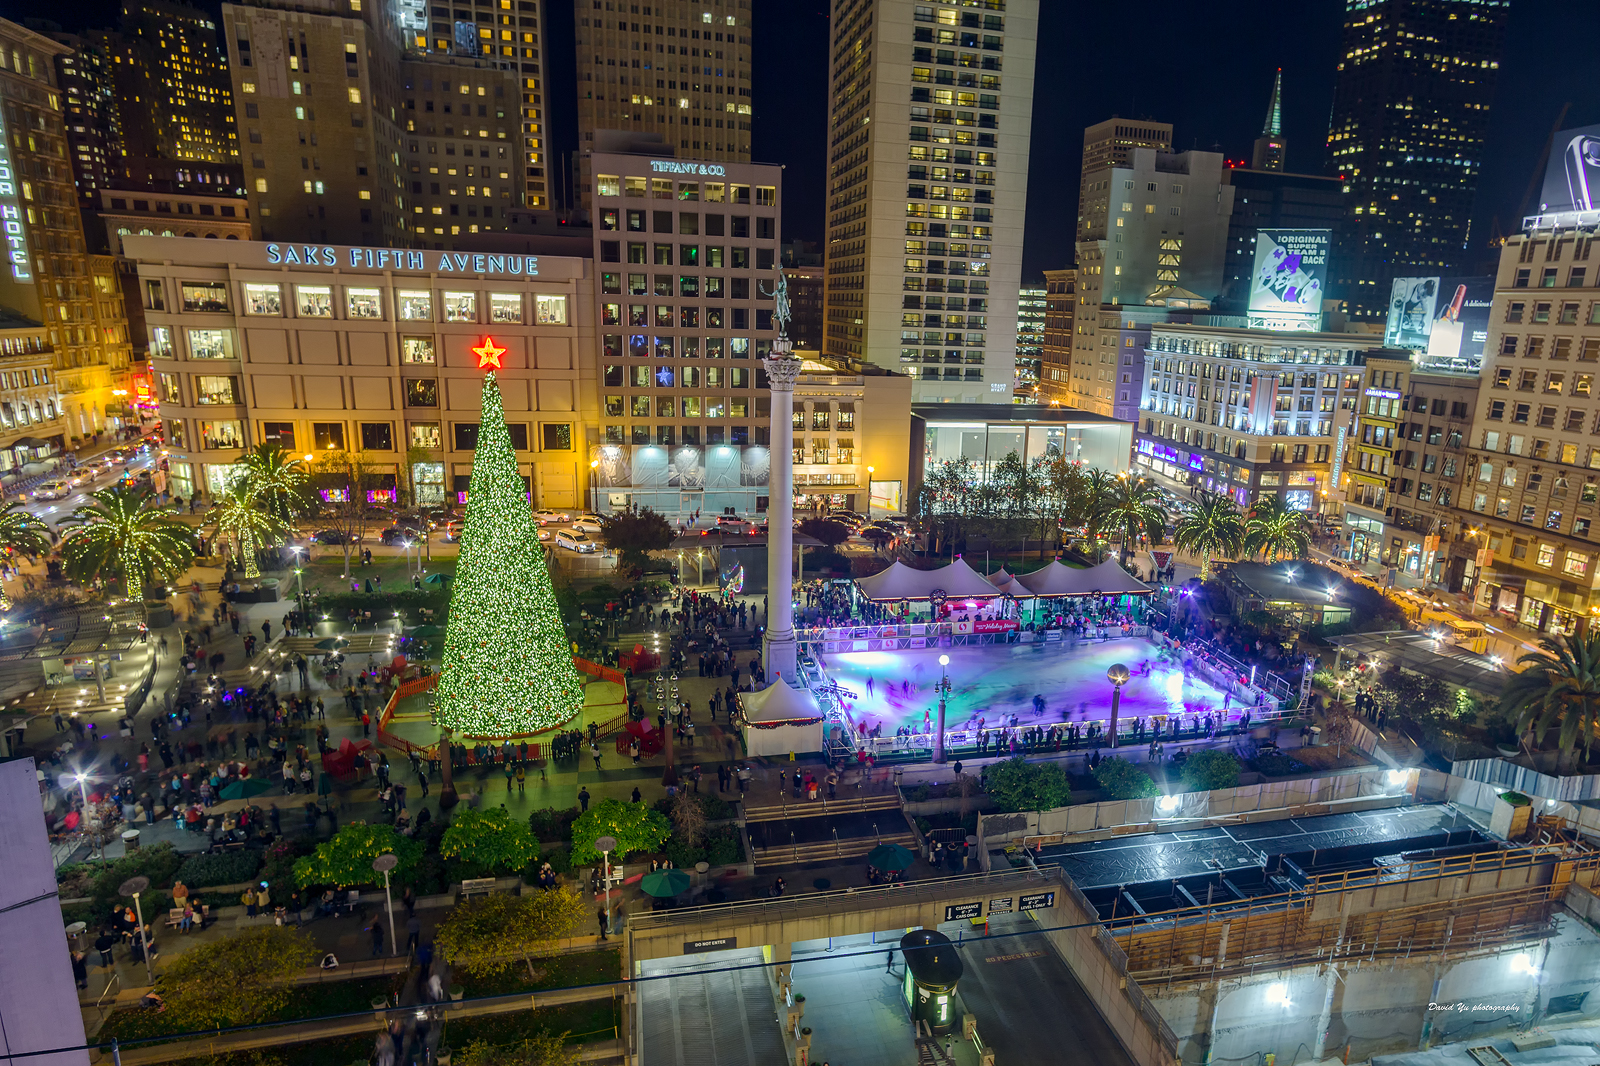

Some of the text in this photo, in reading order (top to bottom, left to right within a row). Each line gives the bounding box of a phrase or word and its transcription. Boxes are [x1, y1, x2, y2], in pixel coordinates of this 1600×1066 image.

[650, 160, 726, 177] TIFFANY & CO.
[1, 205, 30, 279] HOTEL
[1281, 235, 1328, 244] ORIGINAL
[266, 243, 539, 275] SAKS FIFTH AVENUE
[1302, 256, 1325, 264] BACK
[1464, 299, 1469, 307] A
[1022, 894, 1045, 902] CLEARANCE
[955, 903, 979, 911] CLEARANCE
